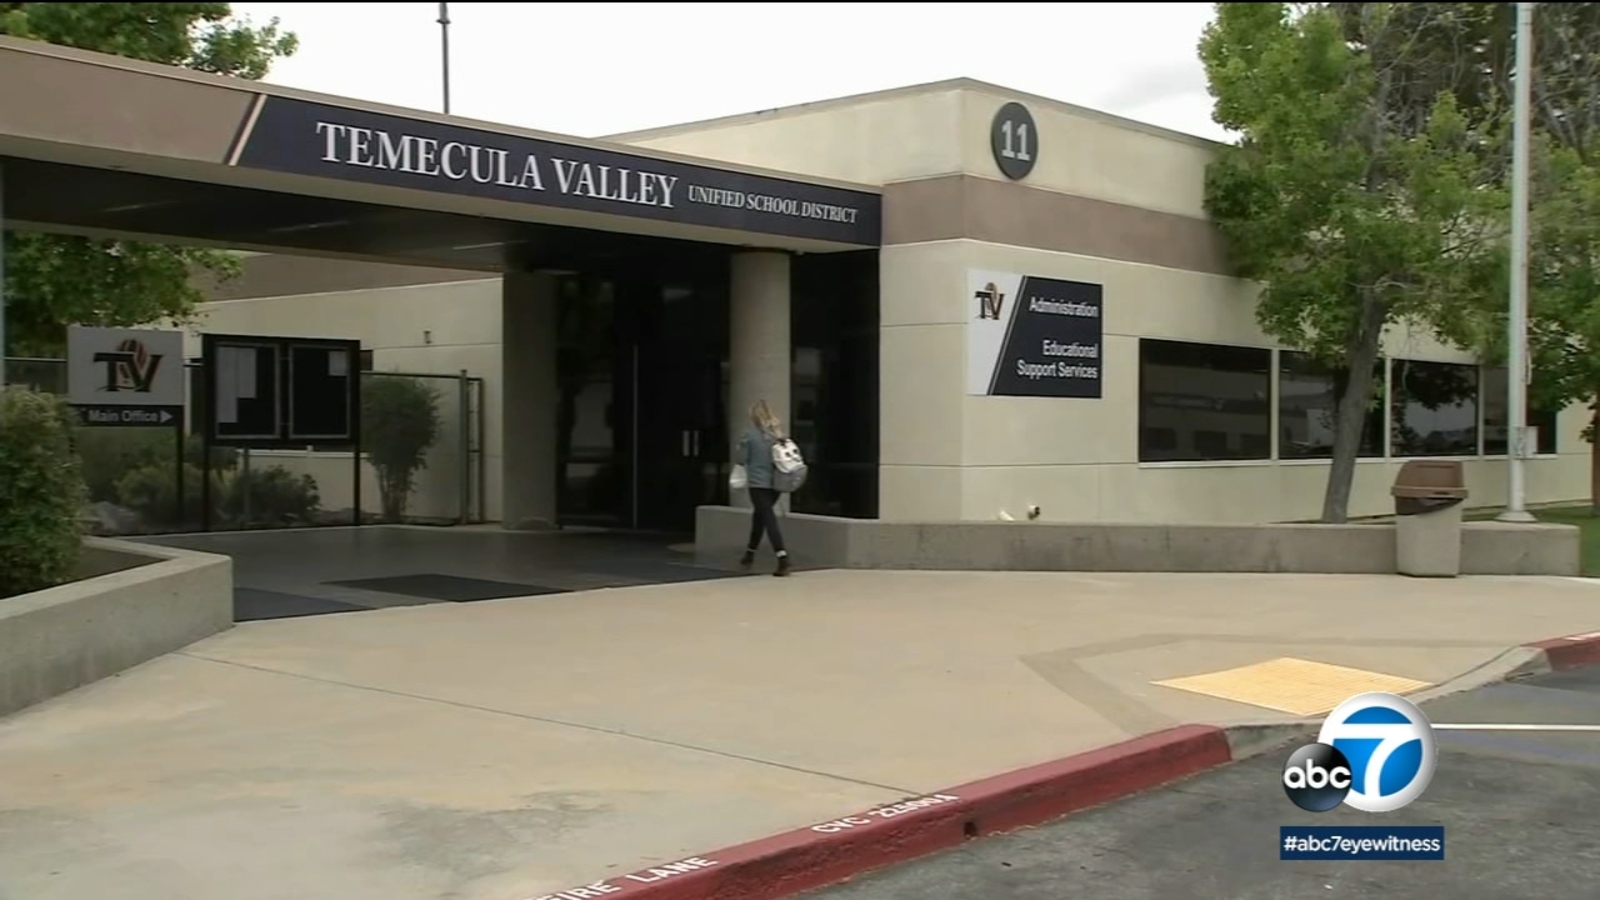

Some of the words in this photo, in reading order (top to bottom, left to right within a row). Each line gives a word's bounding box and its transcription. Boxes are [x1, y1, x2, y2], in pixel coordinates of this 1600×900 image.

[1001, 120, 1031, 161] 11
[315, 121, 546, 191] TEMECULA
[550, 157, 679, 208] VALLEY
[688, 184, 745, 208] UNIFIED
[746, 193, 800, 216] SCHOOL
[801, 201, 858, 223] DISTRICT
[1028, 296, 1099, 318] Administration
[1042, 339, 1099, 359] Educational
[1016, 359, 1057, 380] Support
[1057, 361, 1098, 379] Services
[88, 409, 120, 422] Main
[121, 409, 158, 422] Office
[811, 817, 871, 834] CVC
[626, 856, 719, 882] LANE
